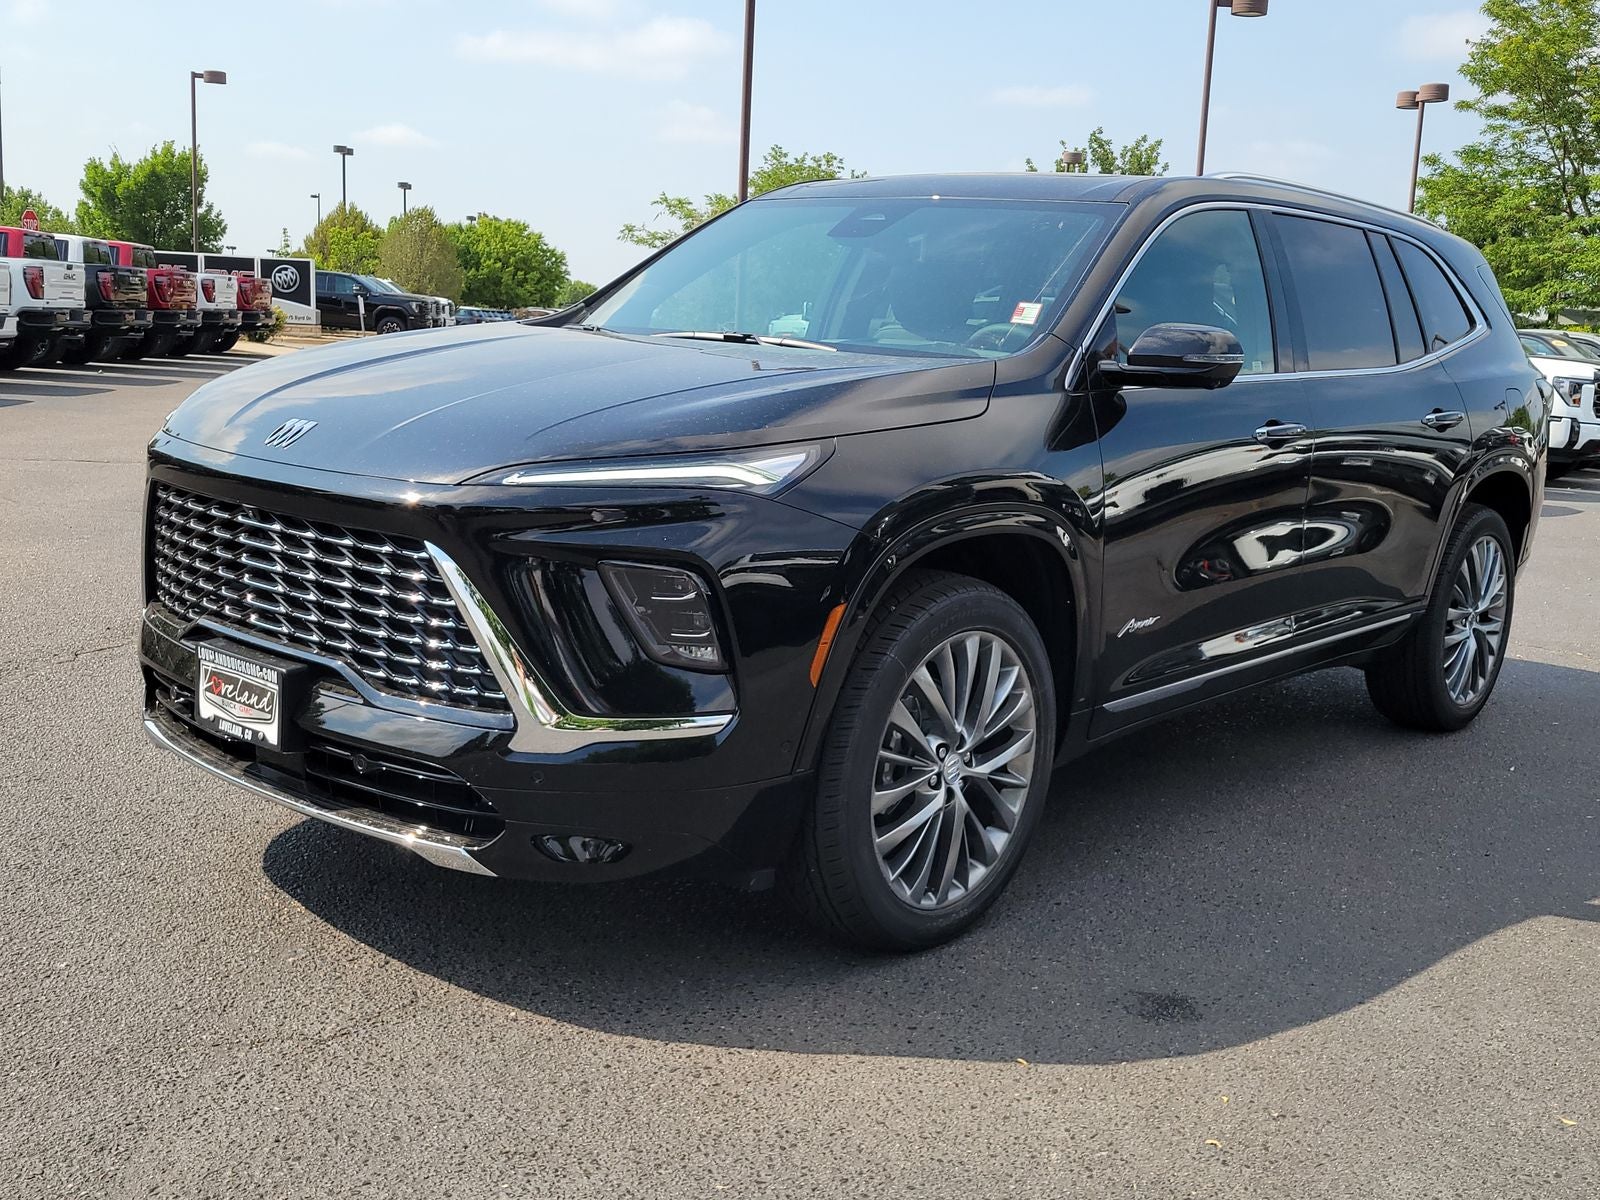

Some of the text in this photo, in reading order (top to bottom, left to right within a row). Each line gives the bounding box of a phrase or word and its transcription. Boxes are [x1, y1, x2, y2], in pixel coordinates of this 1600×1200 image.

[23, 218, 38, 230] STOP
[158, 263, 187, 273] GMC
[221, 698, 254, 716] BUICK GMC
[244, 729, 253, 741] CO
